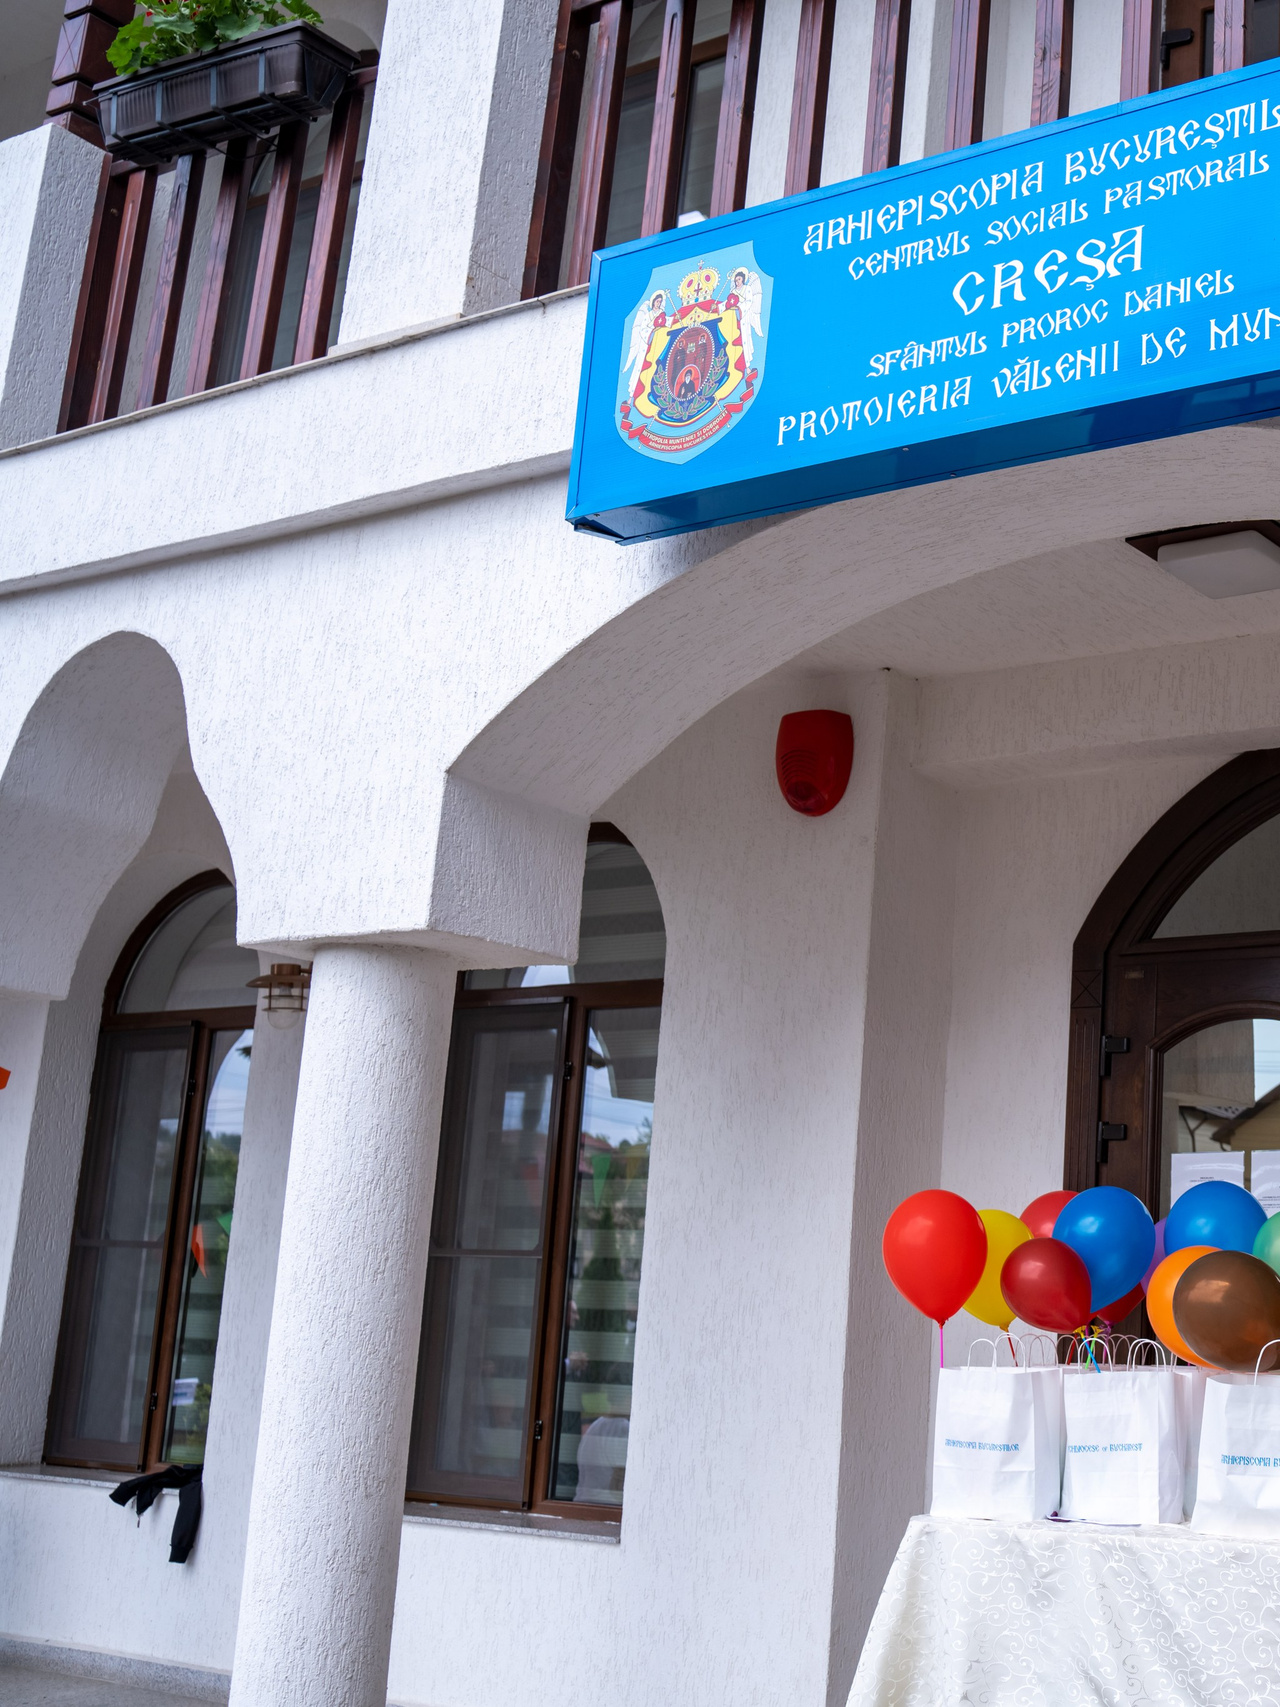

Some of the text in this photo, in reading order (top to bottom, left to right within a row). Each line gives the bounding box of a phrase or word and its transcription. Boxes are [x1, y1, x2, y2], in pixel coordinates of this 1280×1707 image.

[803, 161, 1044, 255] ARHIEPISCOPIA
[848, 149, 1270, 281] CENTRUL SOCIAL PASTORAL
[866, 269, 1235, 378] SFÂNTUL PROROC DANIEL
[777, 375, 972, 446] PROTOIERIA
[991, 340, 1119, 398] VĂLENII
[1141, 326, 1187, 366] DE
